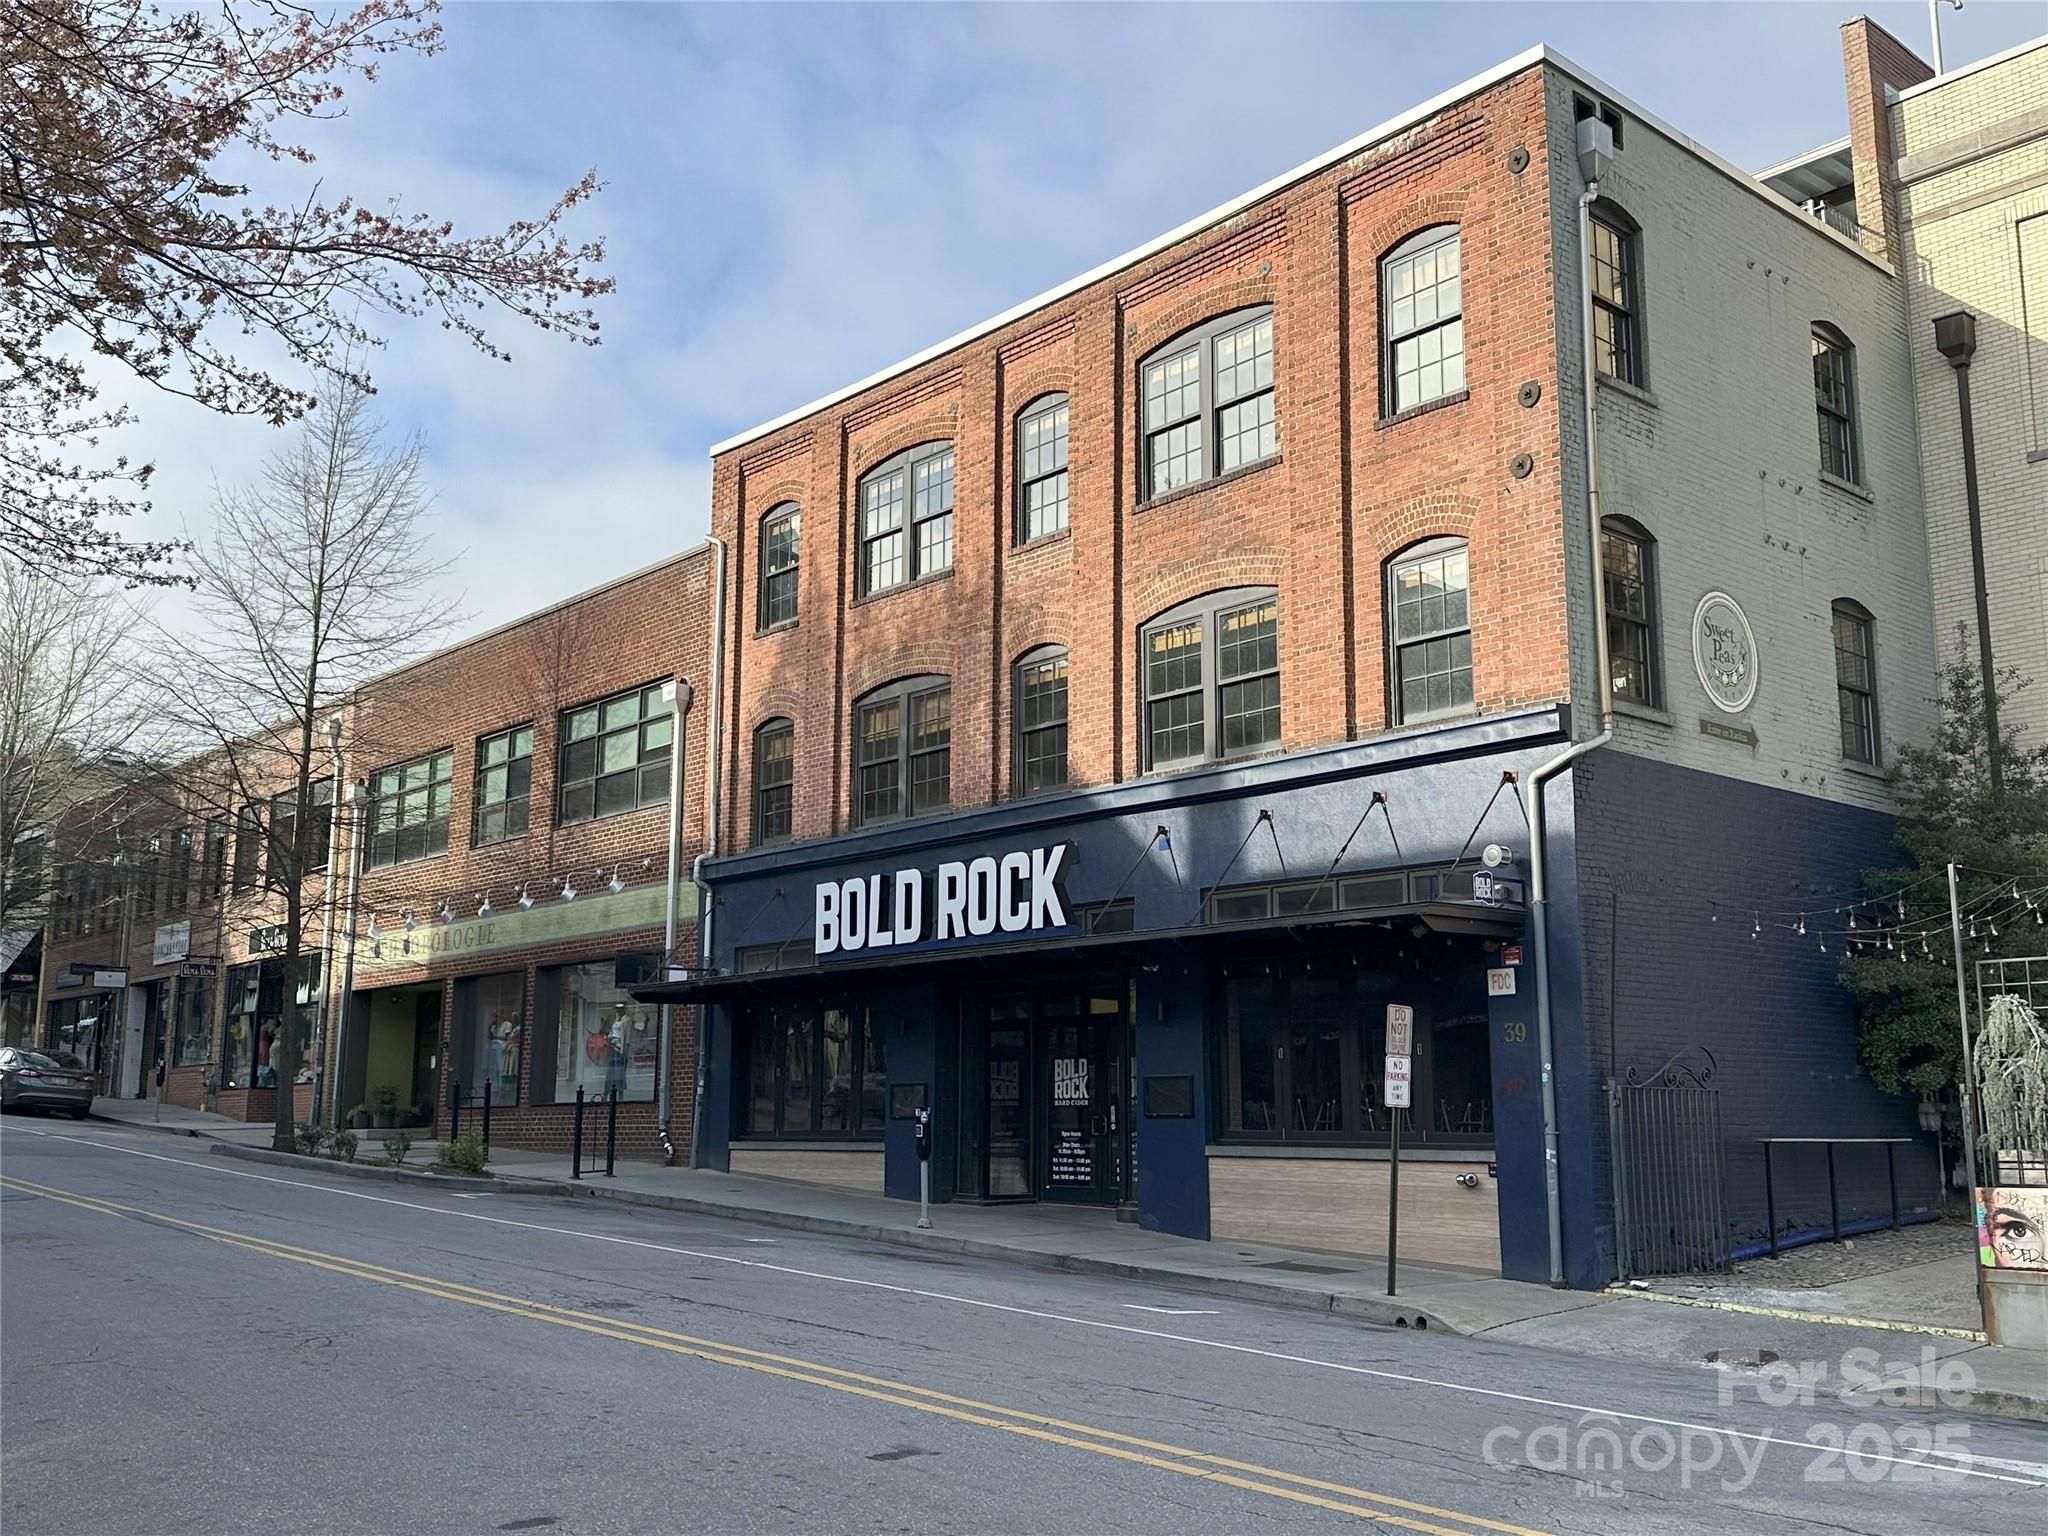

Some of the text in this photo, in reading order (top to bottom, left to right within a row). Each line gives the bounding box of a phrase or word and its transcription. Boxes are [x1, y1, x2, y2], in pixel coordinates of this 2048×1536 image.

[1703, 615, 1735, 644] Sweet
[1712, 638, 1736, 665] Peas
[1475, 876, 1491, 887] BOLD
[815, 844, 1068, 955] BOLD ROCK
[1475, 887, 1492, 898] ROCK
[1492, 973, 1511, 991] FDC
[1394, 1008, 1407, 1022] DO
[1391, 1023, 1408, 1036] NOT
[1504, 1022, 1526, 1042] 39
[1054, 1058, 1088, 1082] BOLD
[1393, 1061, 1403, 1070] NO
[1387, 1071, 1409, 1081] PARKING
[1054, 1076, 1089, 1099] ROCK
[1392, 1084, 1403, 1092] ANY
